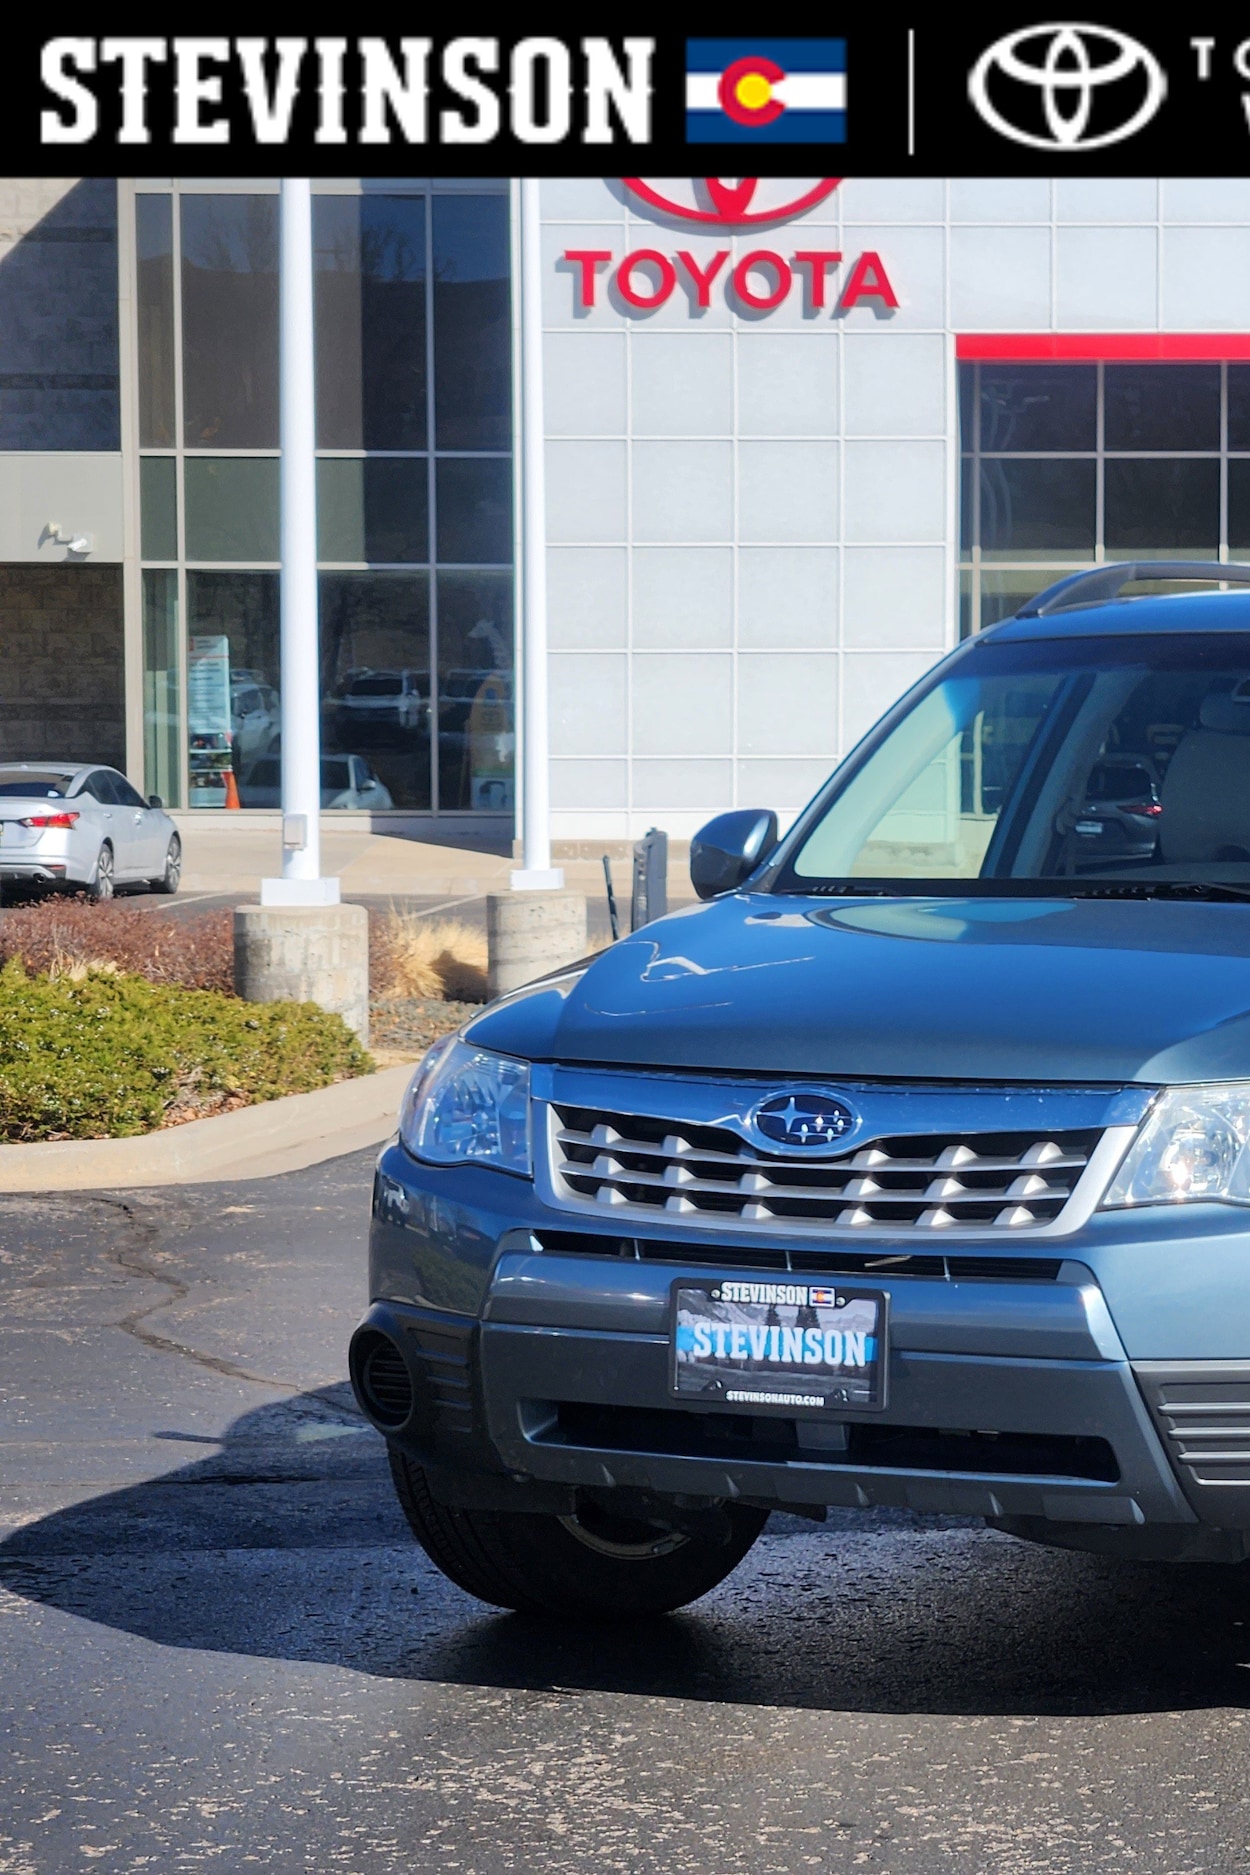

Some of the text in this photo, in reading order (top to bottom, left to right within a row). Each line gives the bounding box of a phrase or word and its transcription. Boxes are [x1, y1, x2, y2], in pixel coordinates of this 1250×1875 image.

[564, 249, 900, 310] TOYOTA
[720, 1281, 809, 1307] STEVINSON
[692, 1321, 868, 1367] STEVINSON
[725, 1390, 825, 1407] STEVINSONAUTO.COM
